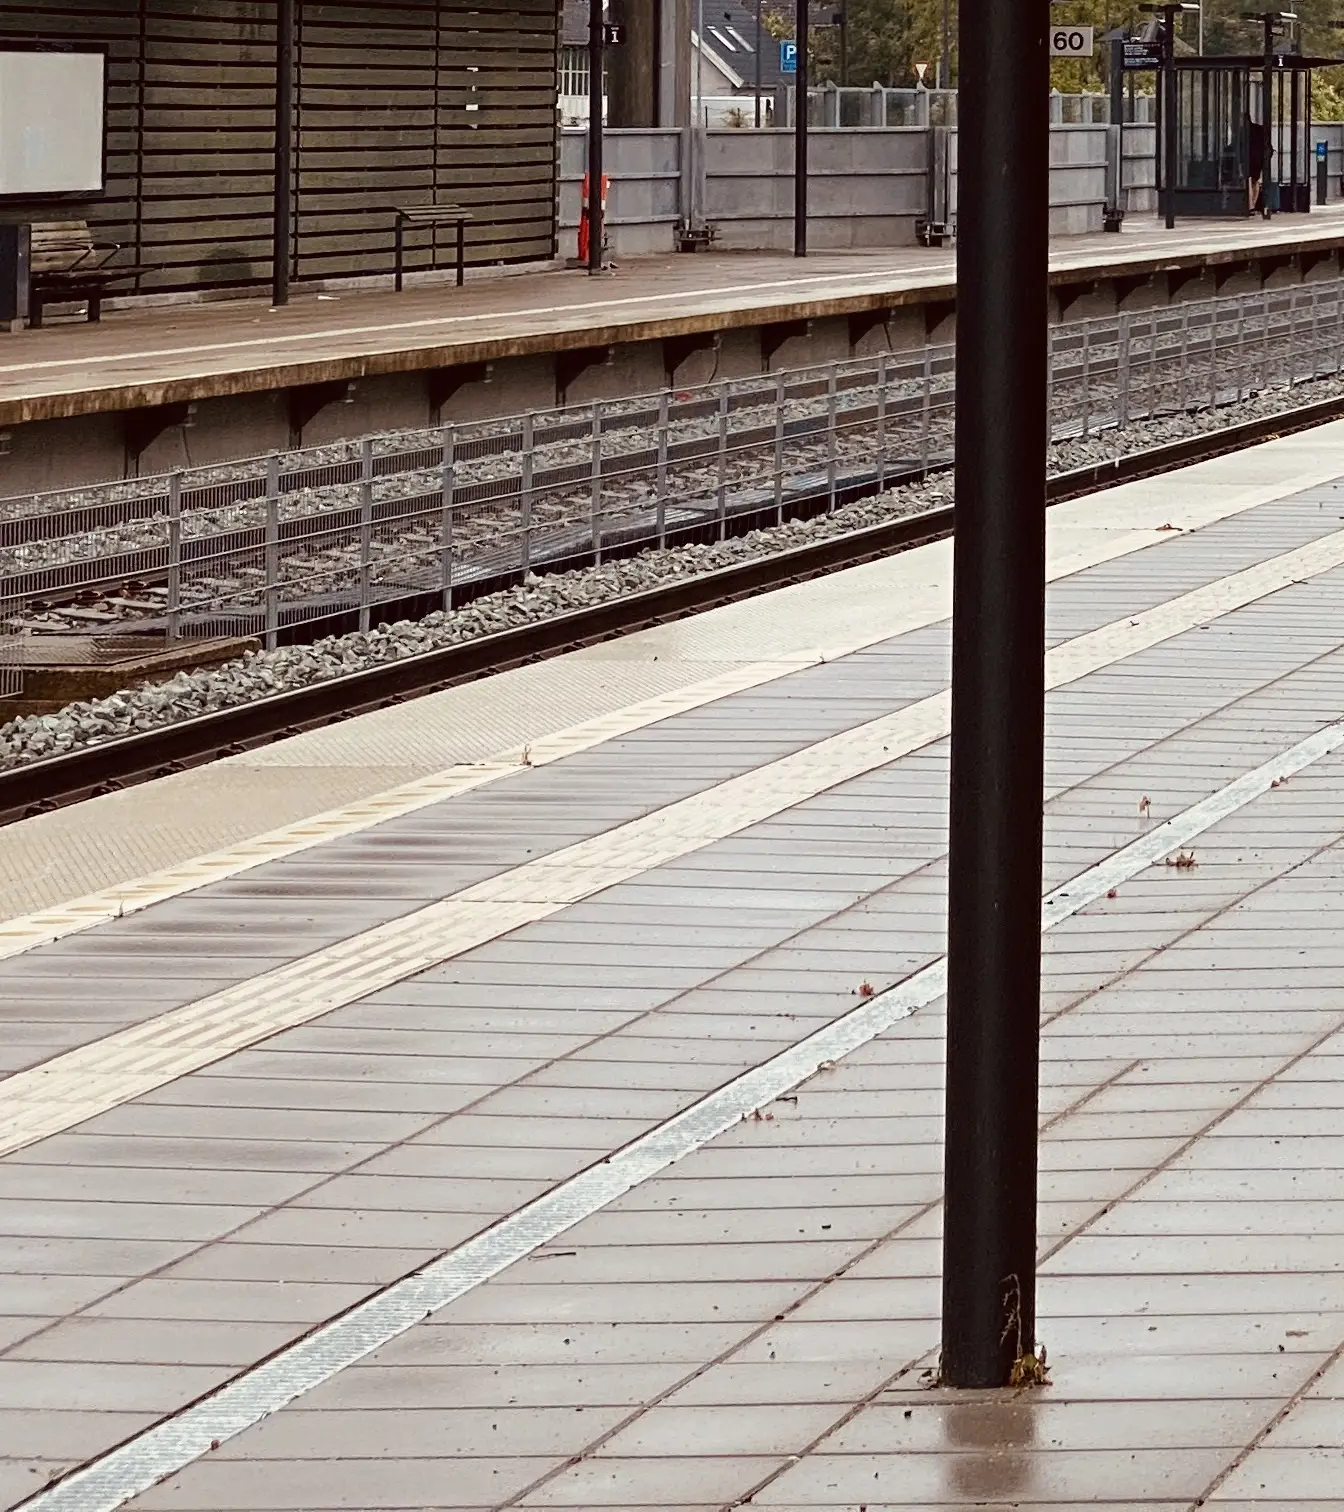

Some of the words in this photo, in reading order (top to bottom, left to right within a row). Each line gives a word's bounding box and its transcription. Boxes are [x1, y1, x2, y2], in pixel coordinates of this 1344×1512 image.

[611, 30, 619, 43] 1
[1053, 31, 1085, 51] 60
[786, 44, 797, 60] P
